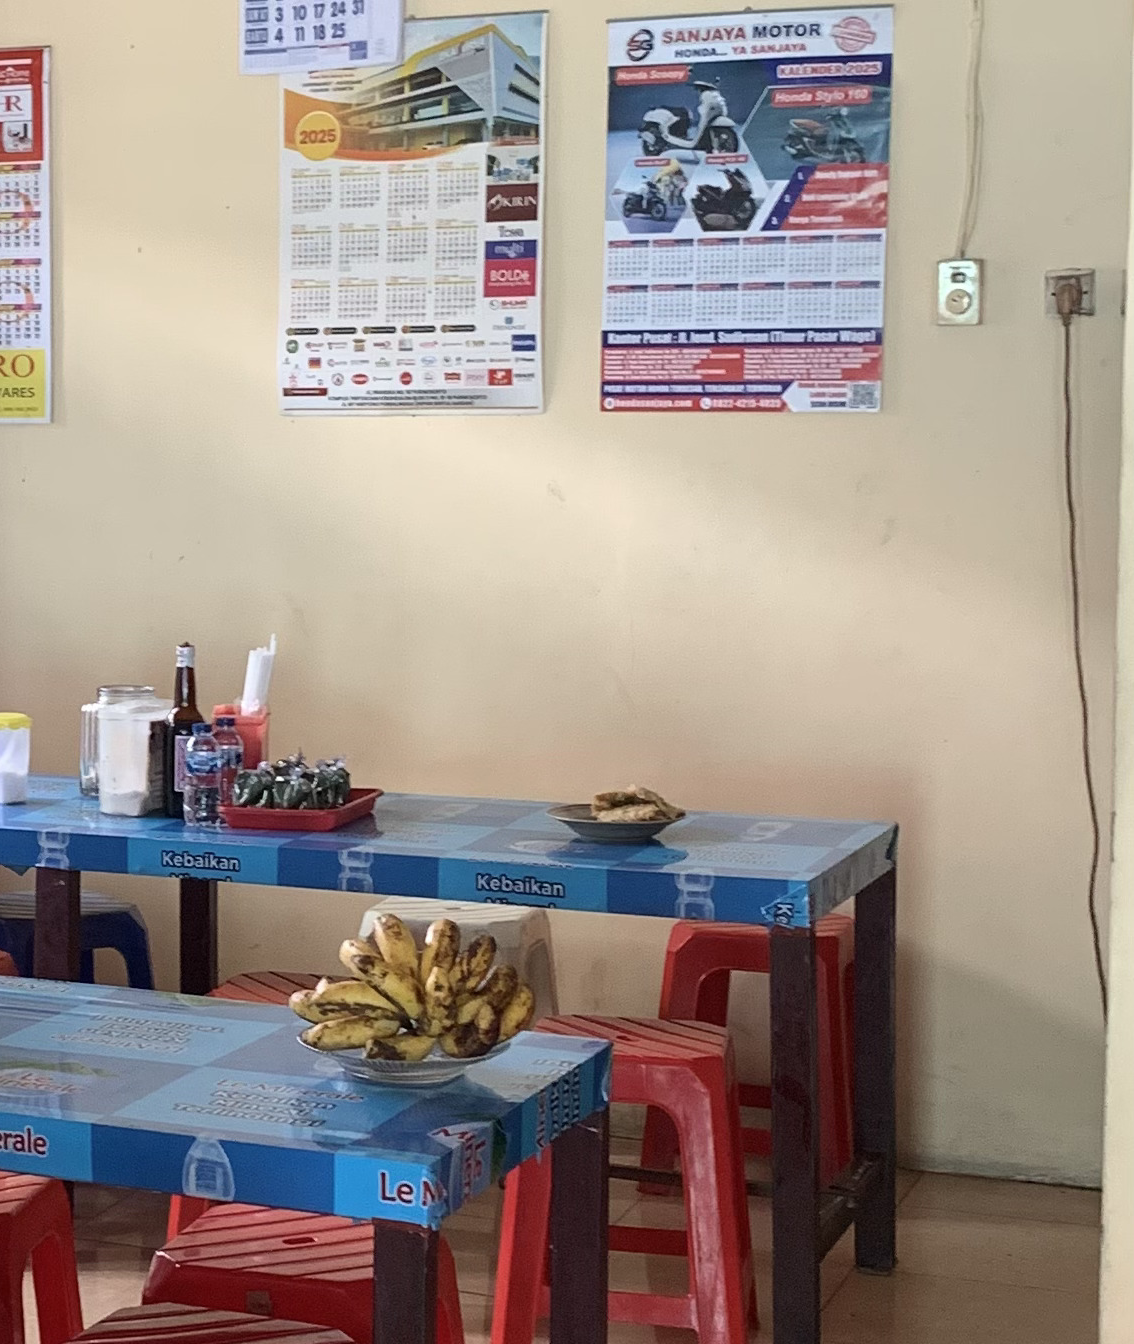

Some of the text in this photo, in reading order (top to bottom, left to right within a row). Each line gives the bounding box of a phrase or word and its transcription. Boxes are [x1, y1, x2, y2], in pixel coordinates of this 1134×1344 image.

[275, 0, 364, 22] 3 10 17 24 31
[274, 23, 346, 43] 4 11 18 25
[661, 23, 822, 44] SANJAYA MOTOR
[731, 46, 747, 55] YA
[751, 43, 807, 54] SANJAYA
[779, 63, 879, 76] KALENDER 2025
[774, 93, 812, 103] Honda
[299, 128, 336, 145] 2025
[161, 850, 240, 872] Kebaikan
[476, 873, 565, 898] Kebaikan
[379, 1171, 414, 1203] Le
